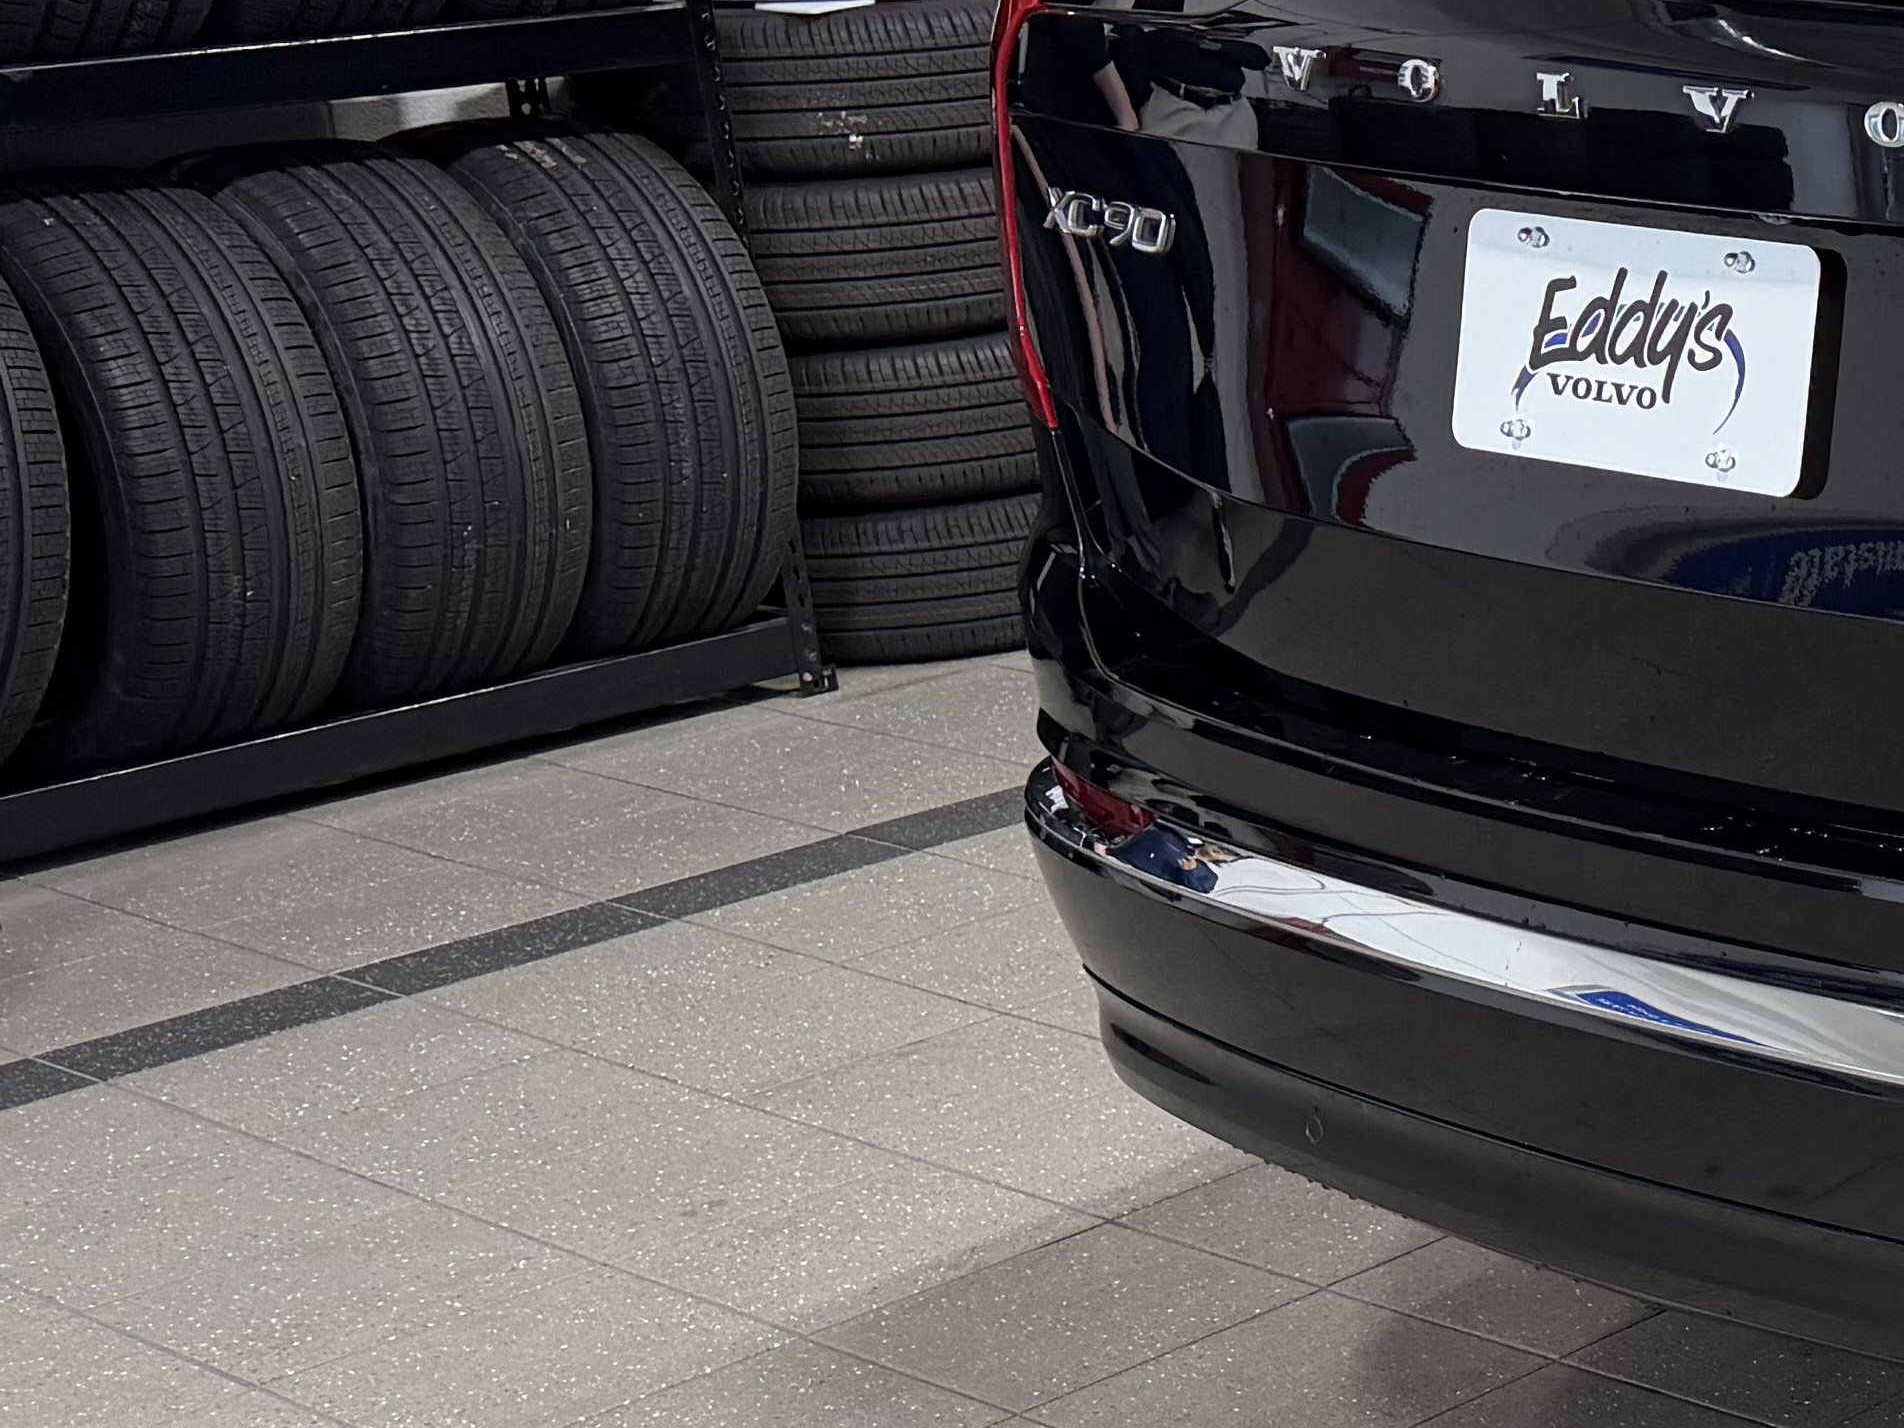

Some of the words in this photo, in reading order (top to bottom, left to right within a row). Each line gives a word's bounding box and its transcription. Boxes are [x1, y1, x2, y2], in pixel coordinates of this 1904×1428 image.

[1042, 187, 1177, 253] XC90
[1528, 266, 1733, 405] Eddy's
[1546, 372, 1658, 410] VOLVO
